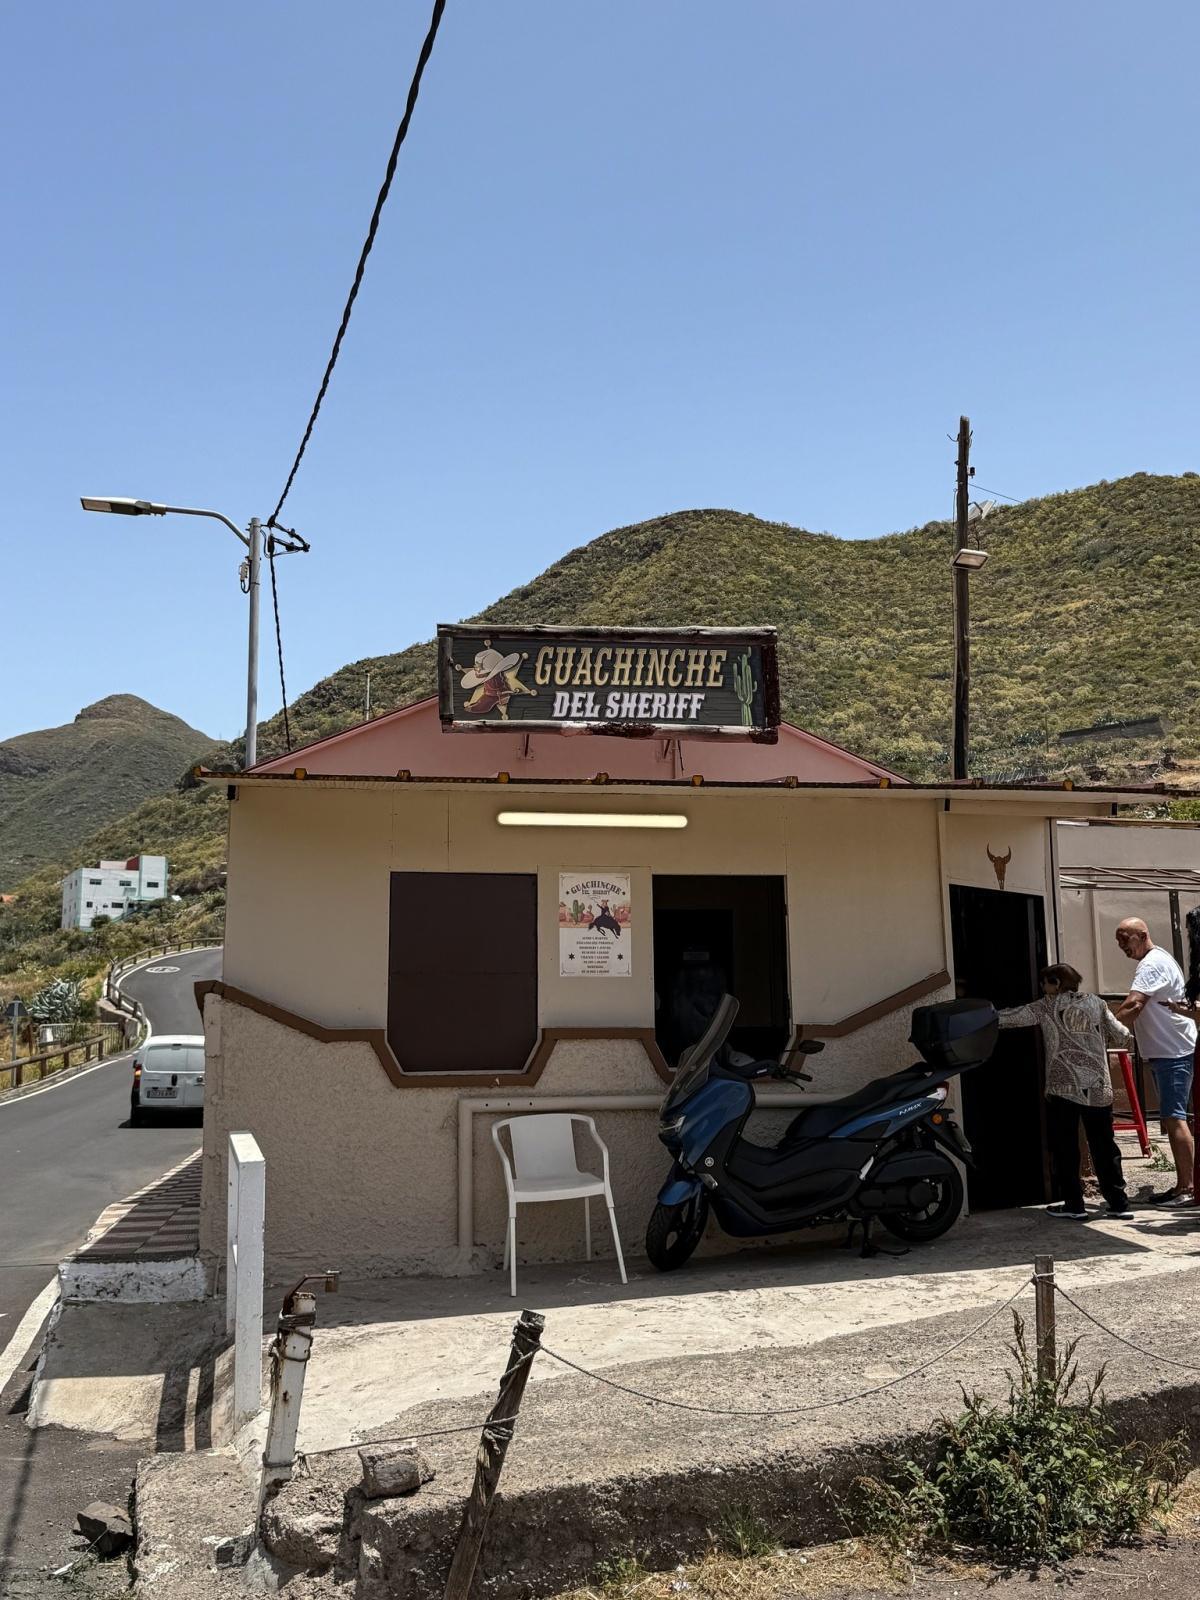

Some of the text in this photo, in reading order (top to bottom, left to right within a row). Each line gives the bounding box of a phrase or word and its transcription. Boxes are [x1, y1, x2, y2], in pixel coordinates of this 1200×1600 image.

[535, 645, 728, 688] GUACHINCHE
[552, 691, 705, 719] DEL SHERIFF
[571, 881, 621, 895] GUACHINCHE
